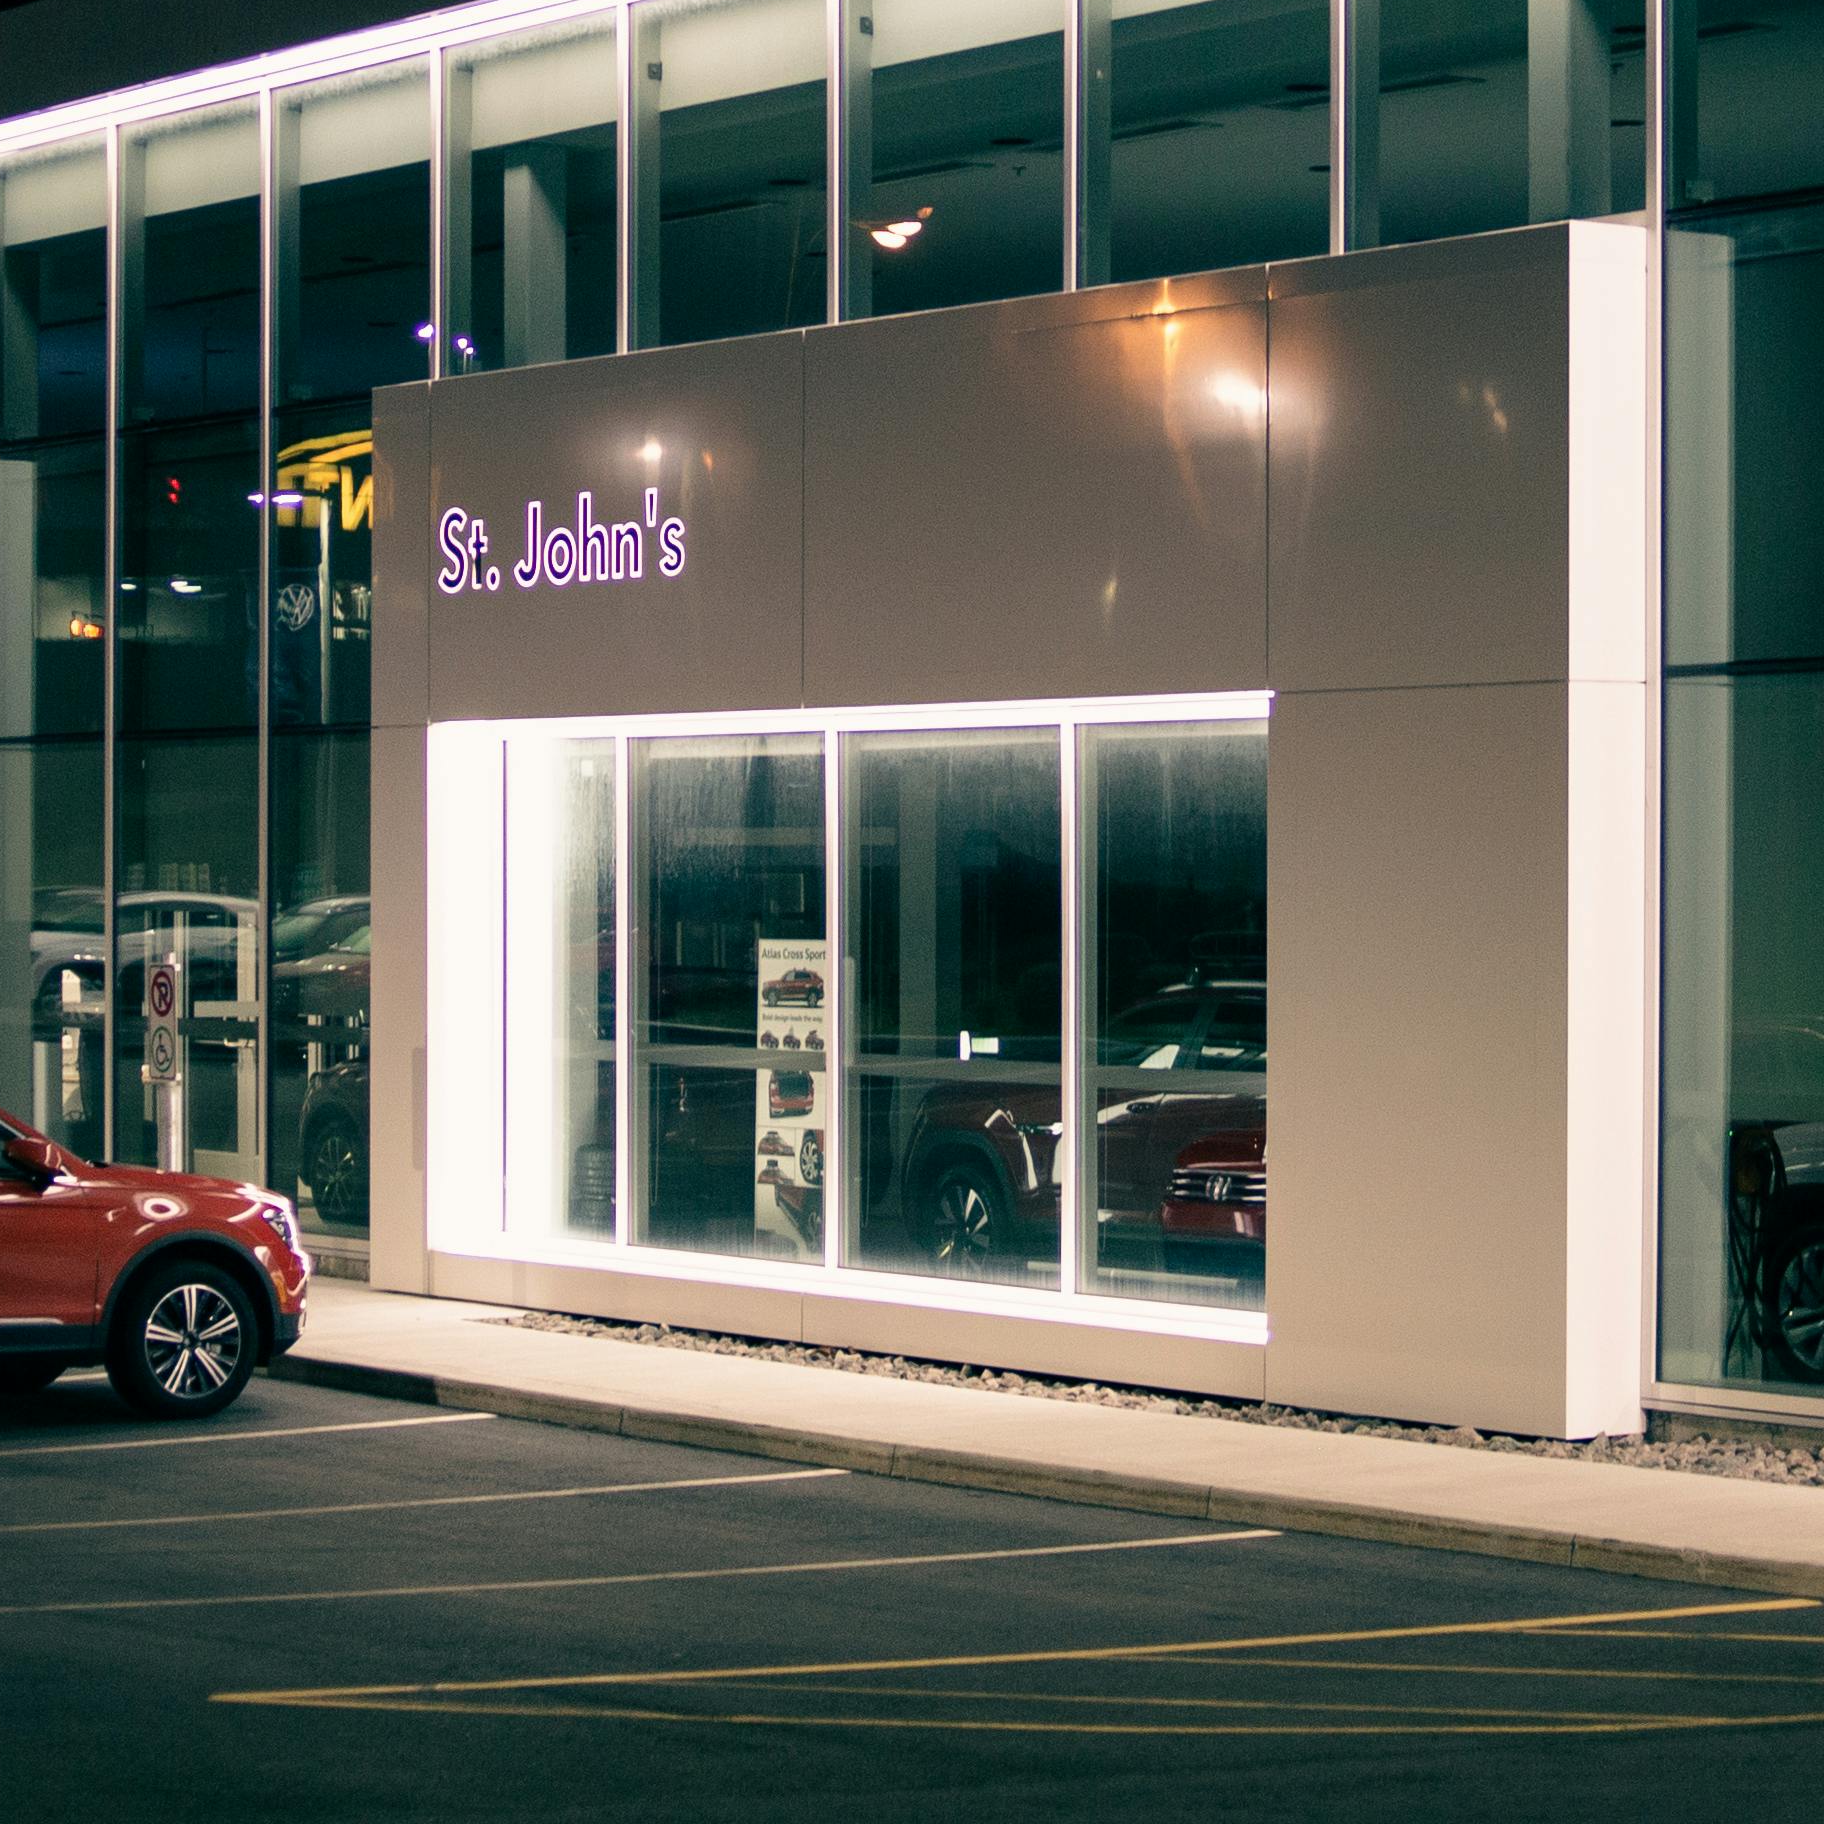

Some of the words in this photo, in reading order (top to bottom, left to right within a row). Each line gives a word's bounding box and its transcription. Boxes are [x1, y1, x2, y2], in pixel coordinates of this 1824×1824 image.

[438, 507, 500, 594] St.
[514, 487, 686, 588] John's
[761, 947, 781, 960] Atlas
[782, 947, 803, 960] Cross
[804, 947, 826, 962] Sport
